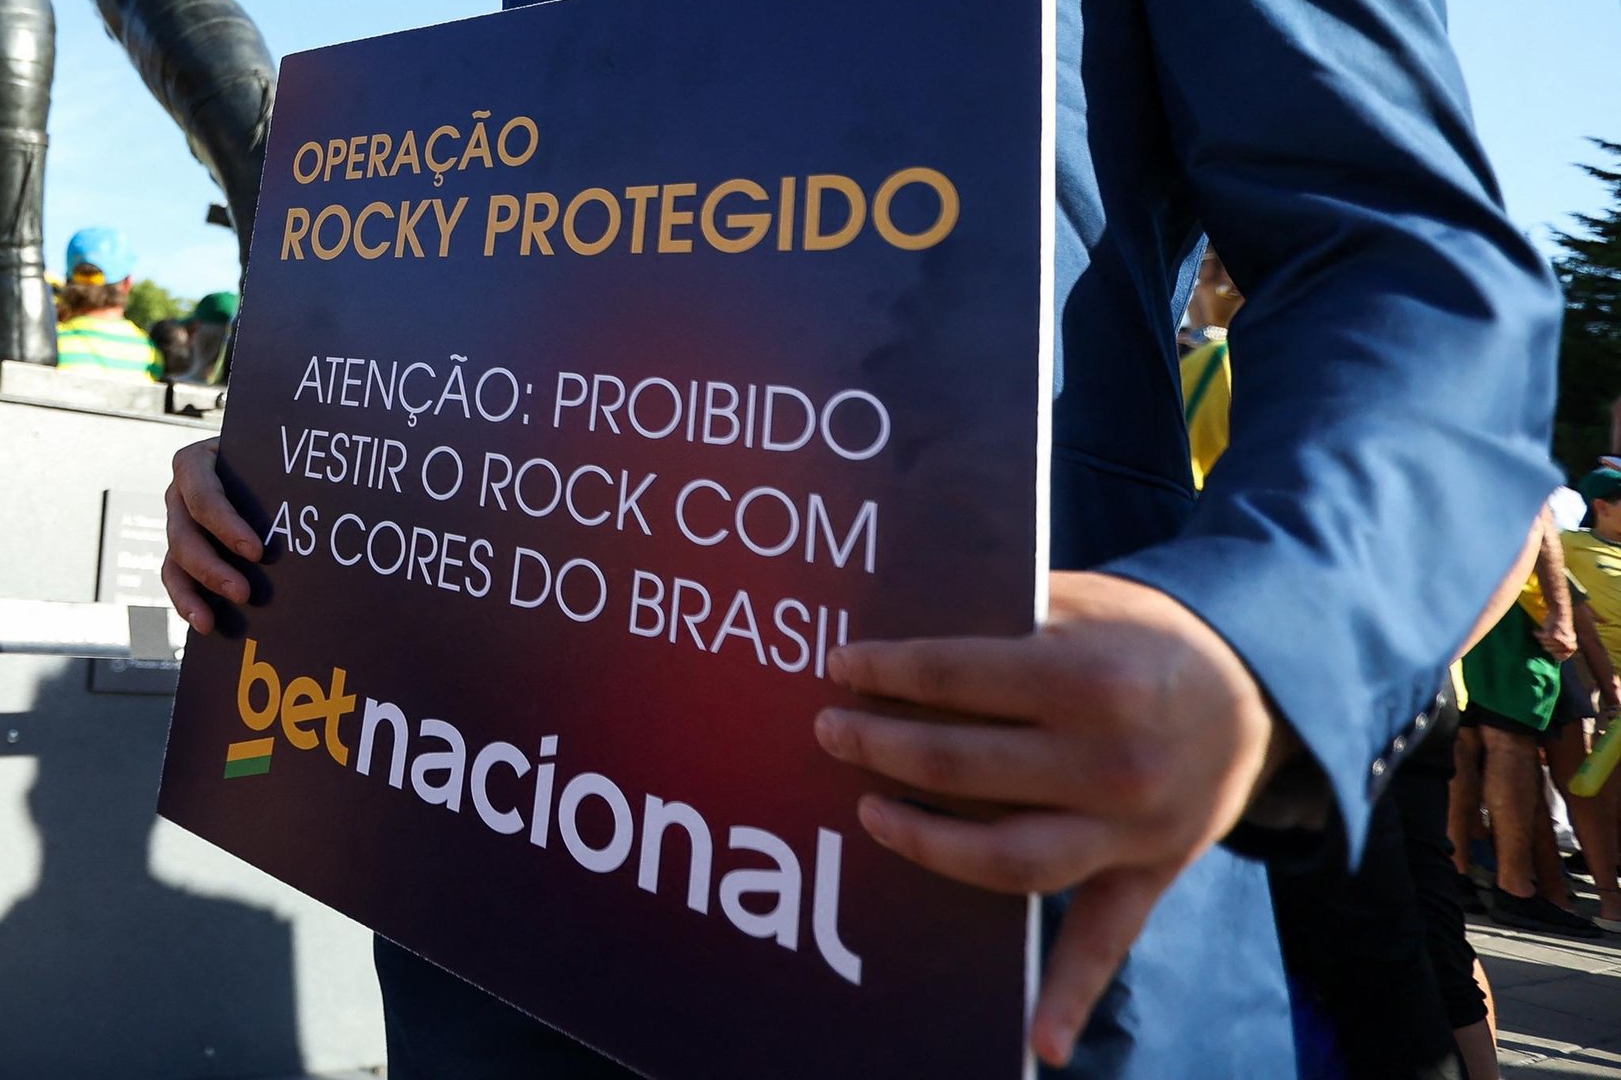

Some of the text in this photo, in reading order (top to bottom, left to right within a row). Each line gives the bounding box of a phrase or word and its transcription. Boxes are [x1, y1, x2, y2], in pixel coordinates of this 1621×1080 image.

[294, 111, 538, 186] OPERAÇÃO
[281, 168, 957, 260] ROCKY PROTEGIDO
[294, 354, 890, 460] ATENÇÃO: PROIBIDO
[281, 426, 877, 572] VESTIR O ROCK COM
[265, 501, 318, 555] AS
[331, 514, 493, 597] CORES
[510, 547, 606, 621] DO
[238, 639, 860, 983] betnacional
